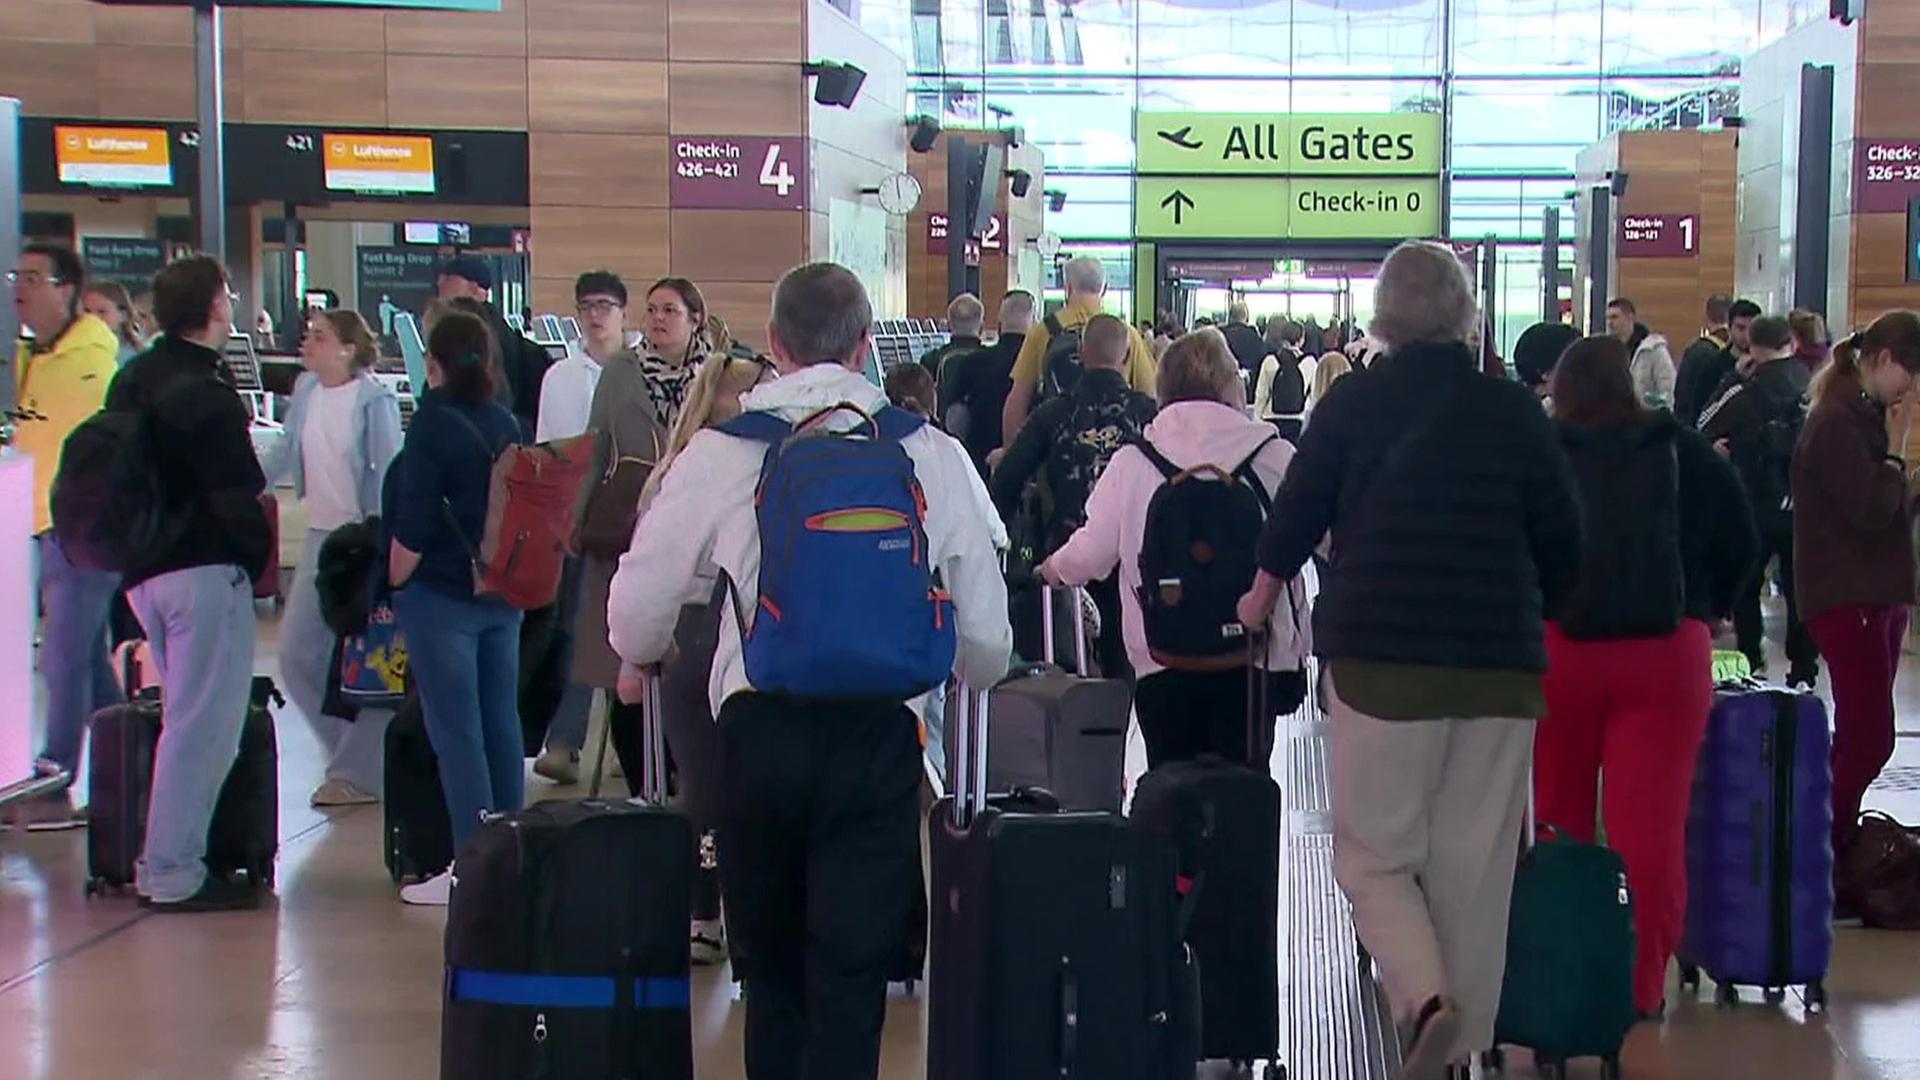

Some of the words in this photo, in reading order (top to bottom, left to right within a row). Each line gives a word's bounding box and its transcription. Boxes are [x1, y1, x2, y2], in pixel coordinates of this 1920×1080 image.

[286, 135, 314, 151] 421
[677, 142, 740, 158] Check-in
[1222, 123, 1279, 160] All
[1300, 126, 1414, 161] Gates
[353, 144, 412, 158] Lufthansa
[1868, 145, 1920, 160] Check-
[677, 162, 738, 177] 426–421
[760, 143, 795, 196] 4
[1298, 191, 1398, 212] Check-in
[1407, 192, 1420, 212] 0
[1624, 217, 1664, 229] Check-in
[981, 216, 1000, 248] 2
[1679, 217, 1693, 250] 1
[363, 253, 384, 264] Fast
[387, 253, 405, 266] Bag
[408, 254, 432, 267] Drop
